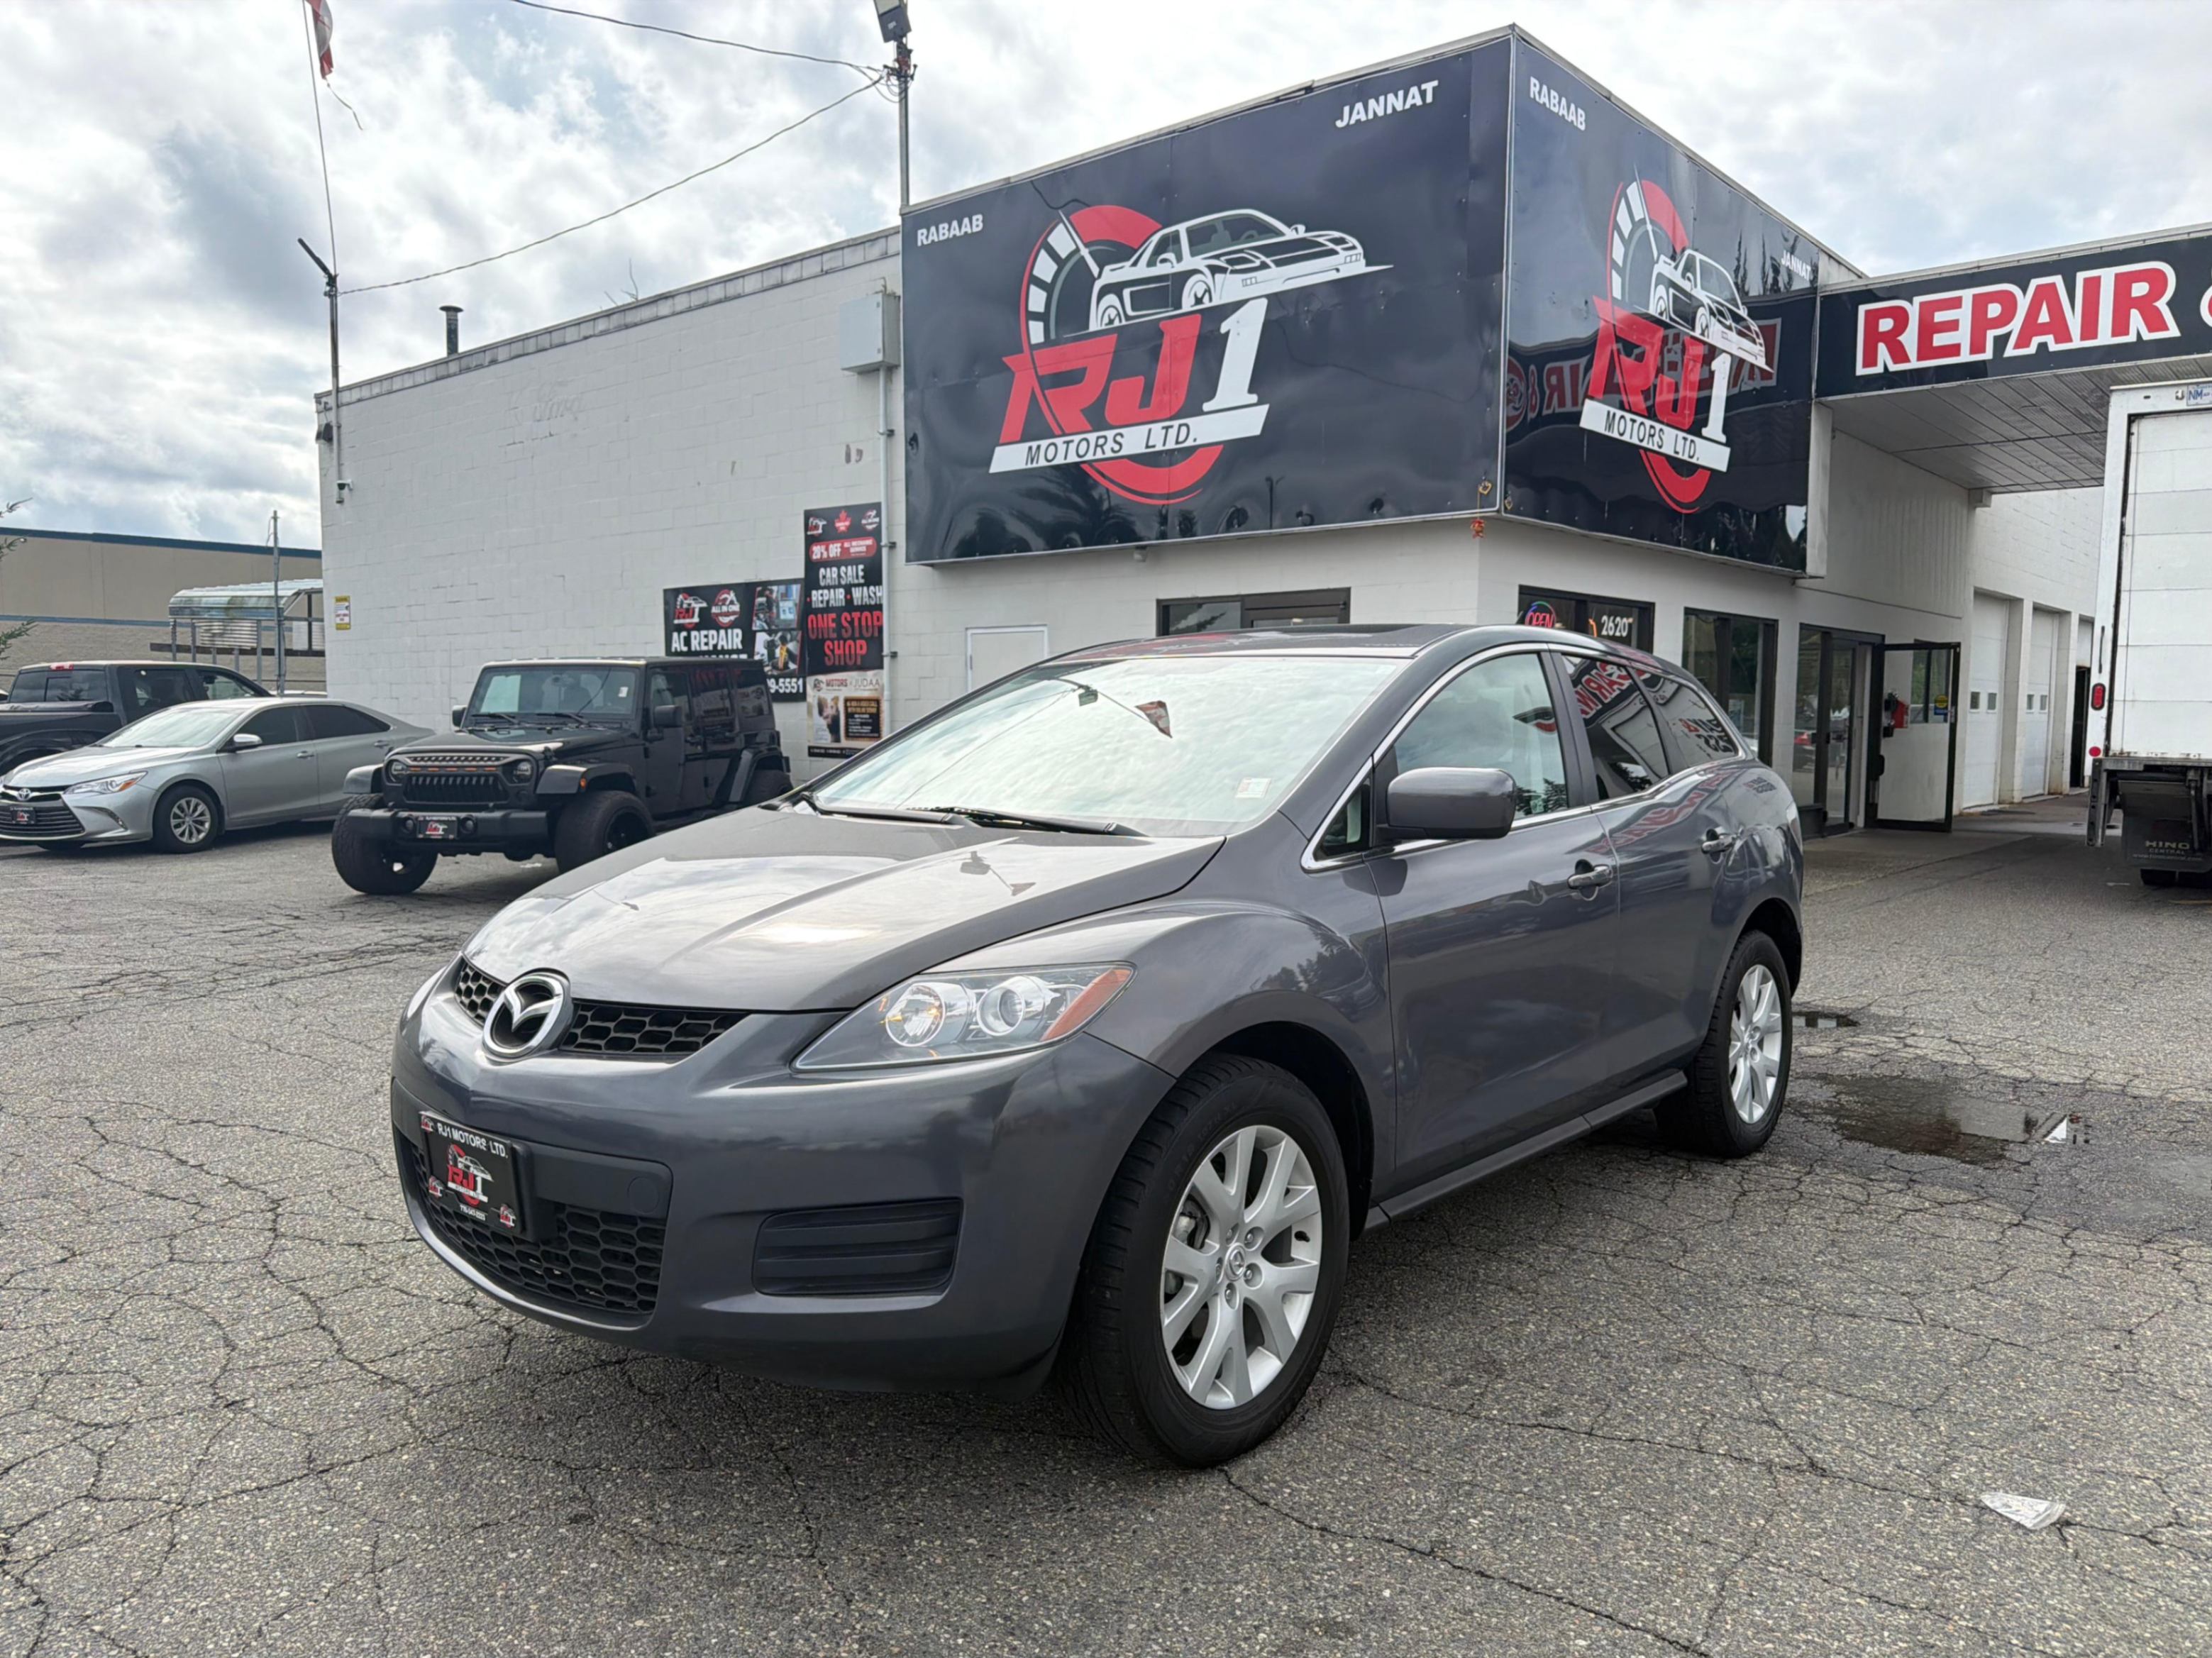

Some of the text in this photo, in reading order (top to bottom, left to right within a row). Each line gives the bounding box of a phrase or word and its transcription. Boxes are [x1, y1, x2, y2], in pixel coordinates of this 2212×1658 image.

[1335, 79, 1439, 128] JANNAT
[1530, 76, 1586, 131] RABAAB
[917, 214, 983, 247] RABAAB
[1781, 250, 1811, 281] JANNAT
[1856, 262, 2181, 376] REPAIR
[1025, 423, 1198, 466] MOTORS LTD.
[1604, 410, 1701, 461] MOTORS LTD.
[819, 564, 865, 587] CAR SALE
[811, 585, 883, 608] REPAIR WASH
[807, 611, 883, 639] ONE STOP
[1526, 612, 1554, 629] OPEN
[1601, 615, 1629, 637] 2620
[671, 628, 743, 652] AC REPAIR
[824, 639, 868, 666] SHOP
[2145, 841, 2190, 849] HINO
[437, 1122, 508, 1159] RJ1 MOTORS LTD.
